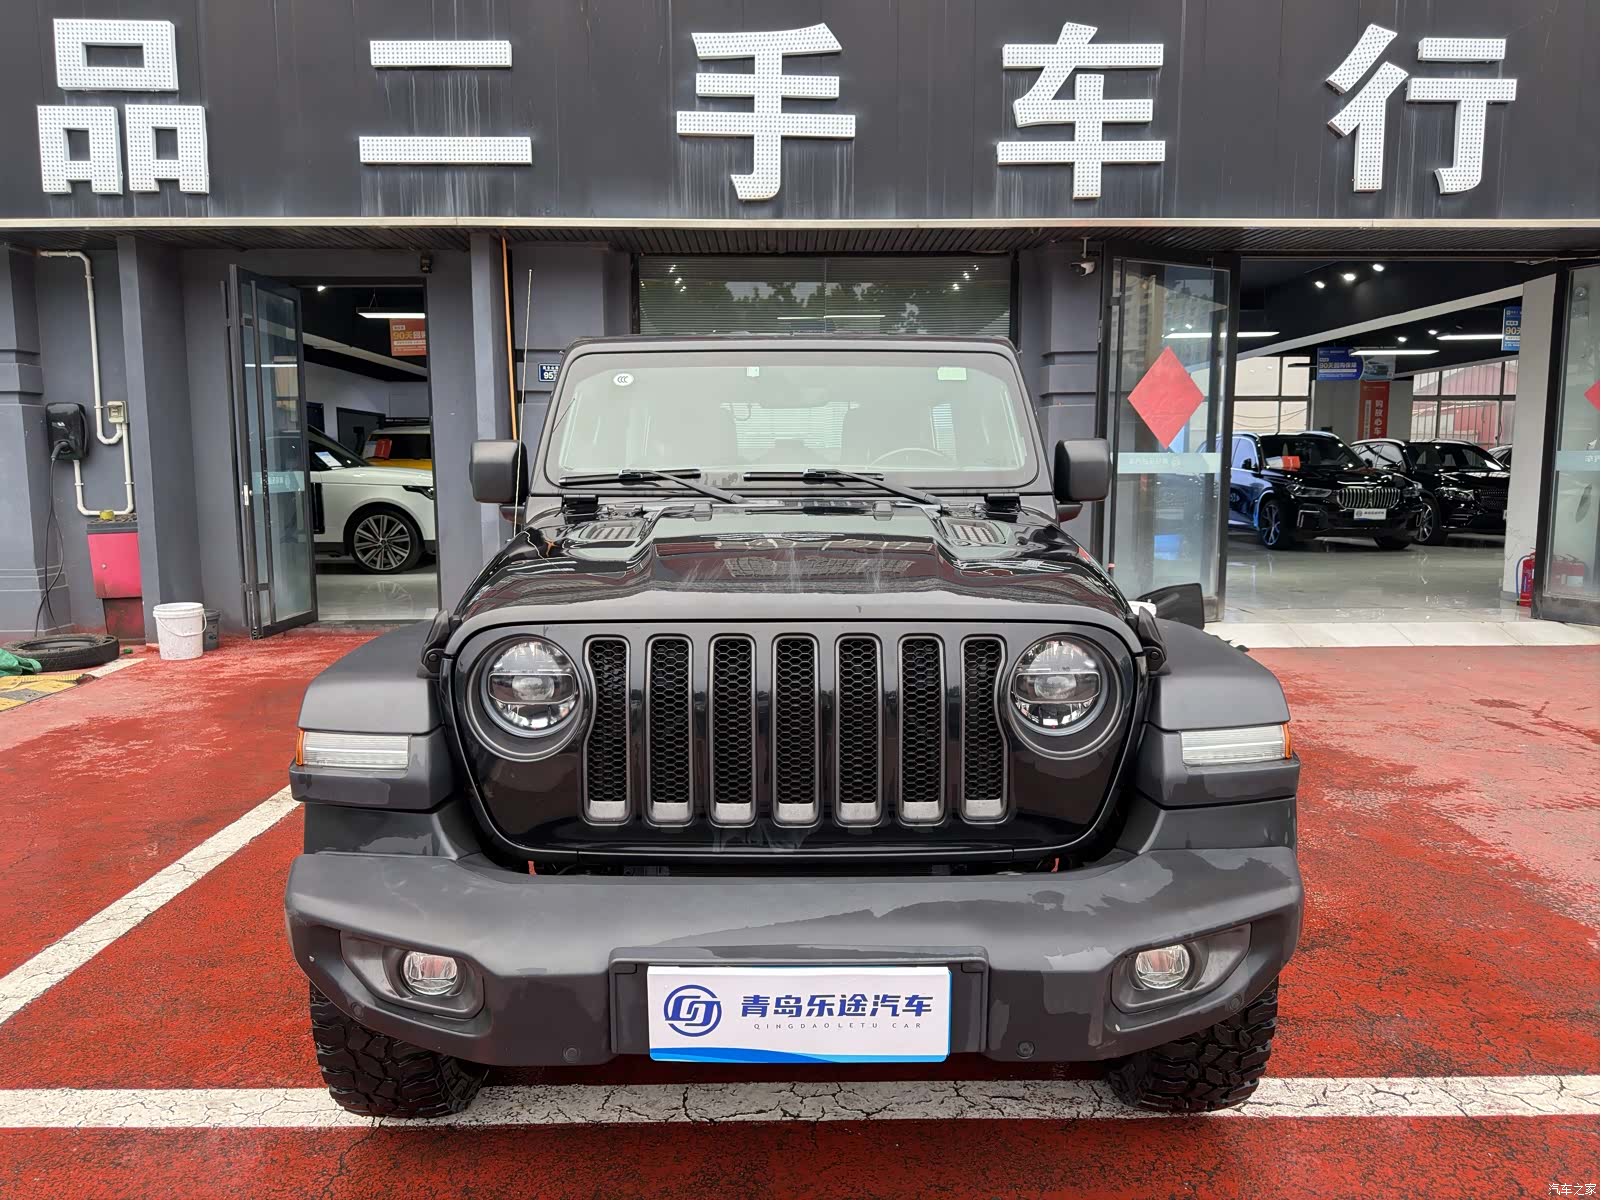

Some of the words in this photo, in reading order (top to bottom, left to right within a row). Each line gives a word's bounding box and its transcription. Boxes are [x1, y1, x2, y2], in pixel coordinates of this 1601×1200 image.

[1319, 361, 1357, 369] 90天回购保障
[741, 993, 934, 1018] 青岛乐途汽车
